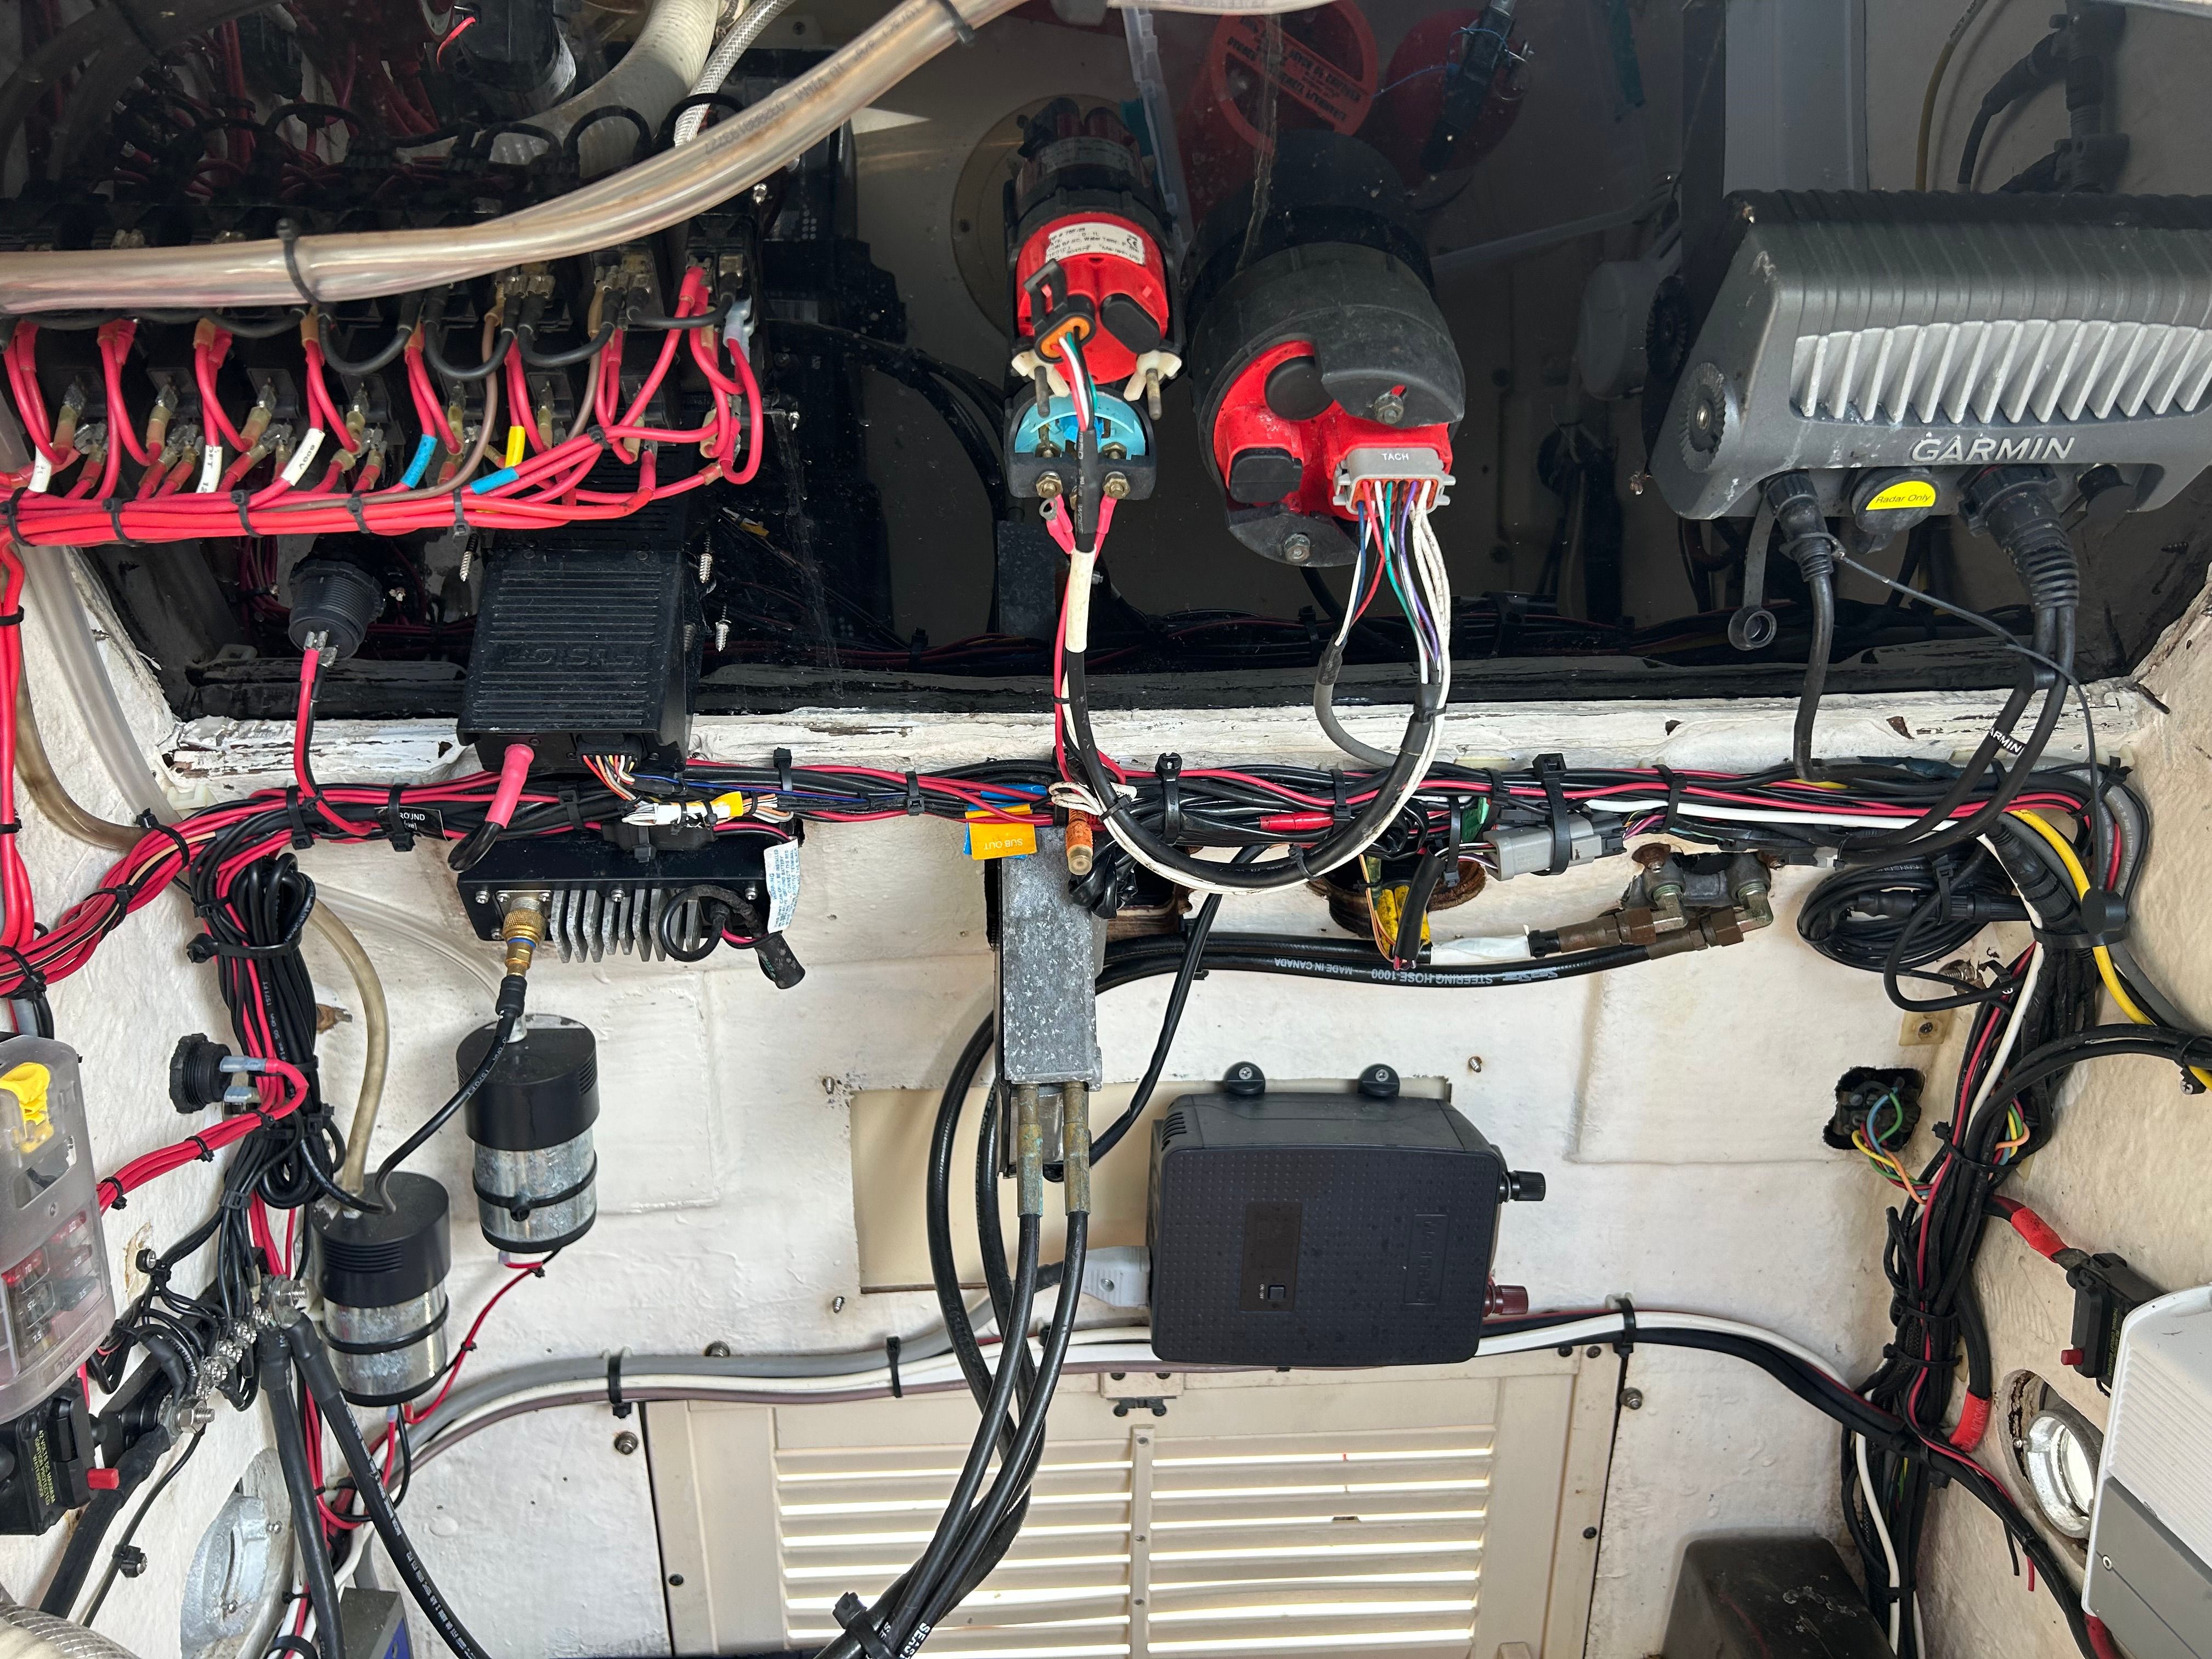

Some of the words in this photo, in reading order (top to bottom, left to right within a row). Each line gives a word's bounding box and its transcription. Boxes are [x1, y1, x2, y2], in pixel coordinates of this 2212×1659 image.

[1911, 435, 2077, 463] GARMIN
[1908, 494, 1932, 503] Only
[1988, 726, 2022, 753] ARMIN
[399, 812, 425, 821] ROUND
[984, 840, 1003, 850] OUT
[1005, 838, 1023, 848] SUB
[1274, 957, 1313, 970] CANADA
[1313, 963, 1325, 972] IN
[1326, 963, 1353, 975] MADE
[1370, 968, 1397, 980] 1000
[1400, 971, 1432, 983] HOSE
[1435, 972, 1493, 984] STEERING
[38, 1430, 44, 1439] 42
[40, 1439, 48, 1462] VOLTS
[35, 1437, 44, 1466] IGNITION
[41, 1467, 51, 1505] PROTECTED
[44, 1460, 50, 1472] DC
[32, 1454, 44, 1497] WATERPROOF
[46, 1472, 56, 1503] MAXIMUM
